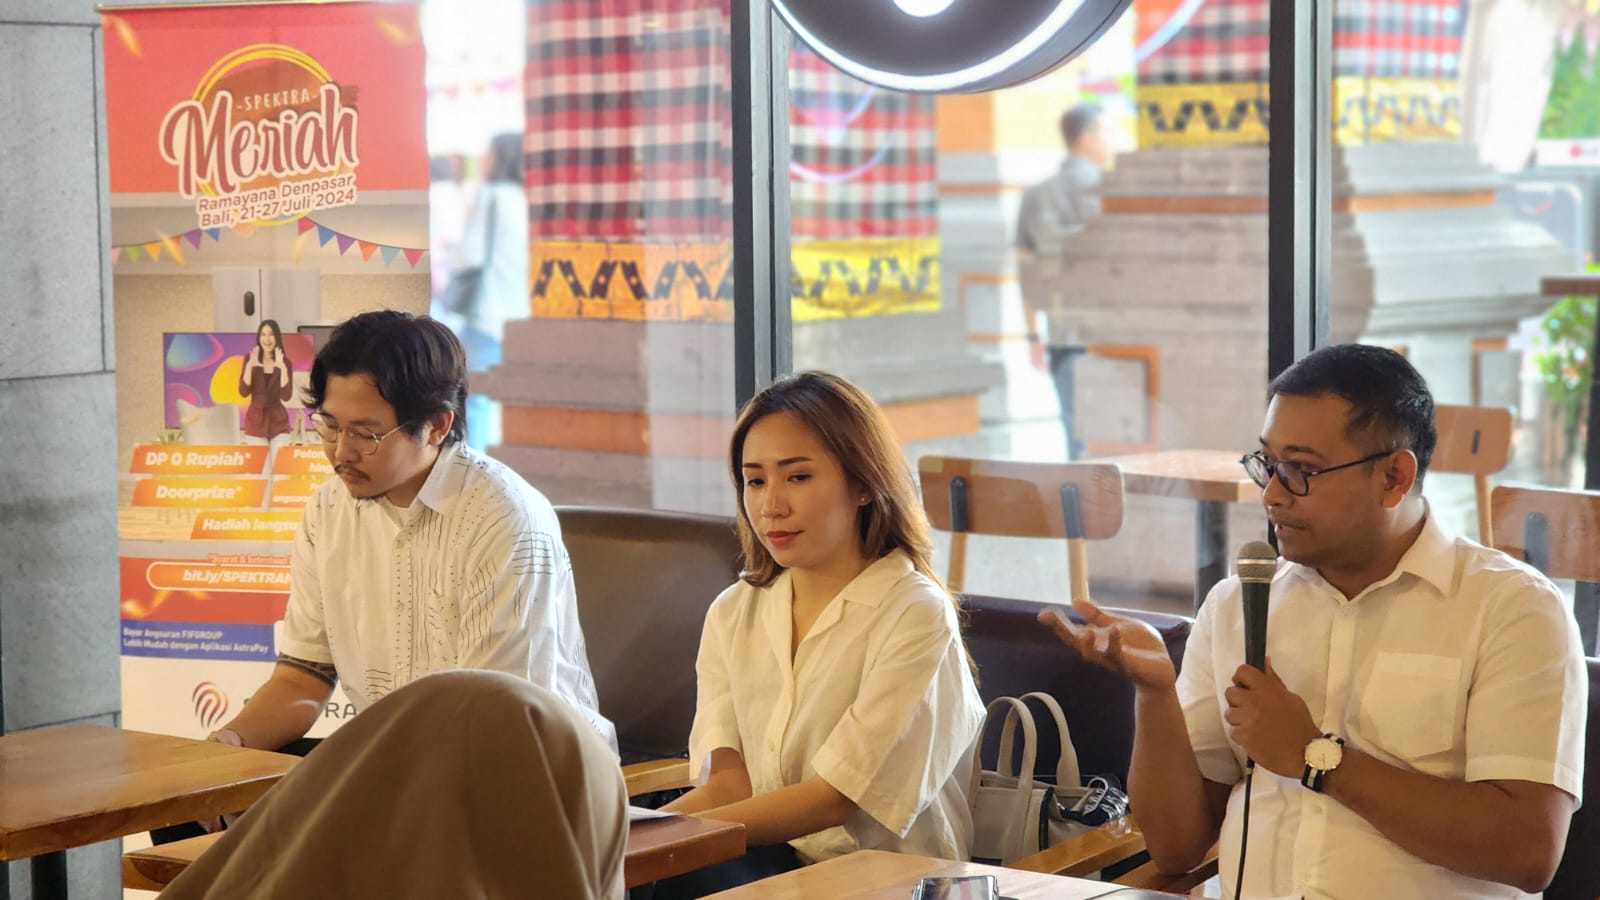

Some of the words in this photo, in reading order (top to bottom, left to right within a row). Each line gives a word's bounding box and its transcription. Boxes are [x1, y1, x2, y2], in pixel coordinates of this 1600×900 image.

[162, 85, 357, 196] Meriah
[199, 189, 276, 211] Ramayana
[282, 176, 353, 198] Denpasar
[201, 209, 234, 226] Bali,
[240, 202, 280, 221] 21-27
[284, 196, 310, 213] Juli
[316, 189, 355, 207] 2024
[145, 452, 168, 466] DP
[293, 449, 328, 460] Poton
[309, 463, 335, 474] hing
[202, 518, 250, 531] Hadiah
[144, 628, 180, 639] Angsuran
[182, 630, 223, 639] FIFGROUP
[143, 639, 169, 648] Mudah
[170, 641, 199, 651] dengan
[200, 641, 232, 652] Aplikasi
[233, 643, 269, 654] AstraPay
